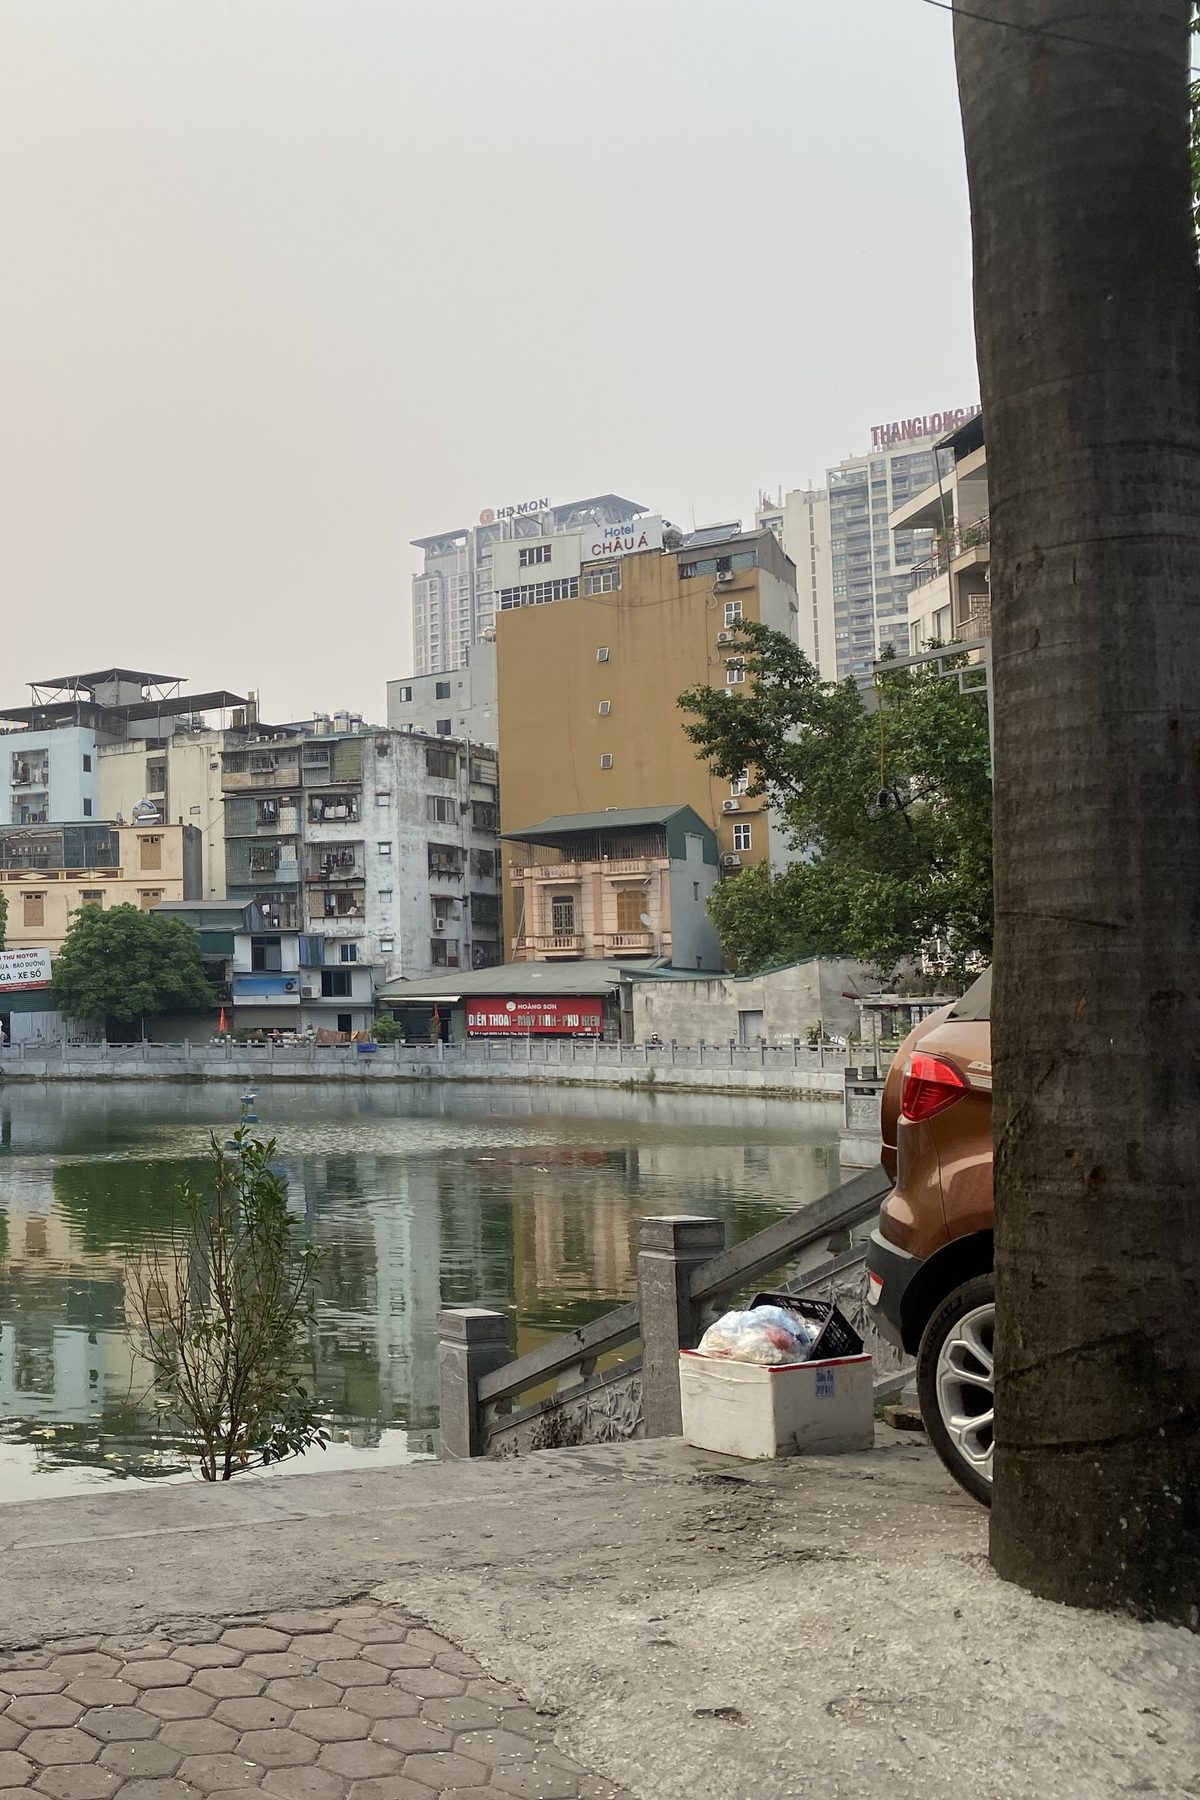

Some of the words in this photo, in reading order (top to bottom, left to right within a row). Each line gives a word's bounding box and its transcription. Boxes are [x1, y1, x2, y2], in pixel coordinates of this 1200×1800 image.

[517, 497, 549, 514] MON
[604, 523, 634, 538] Hotel
[591, 536, 634, 556] CHÂU
[638, 531, 648, 548] Á
[16, 952, 38, 960] MOTOR
[0, 973, 11, 981] GA
[18, 971, 28, 980] XE
[30, 967, 42, 978] SỐ
